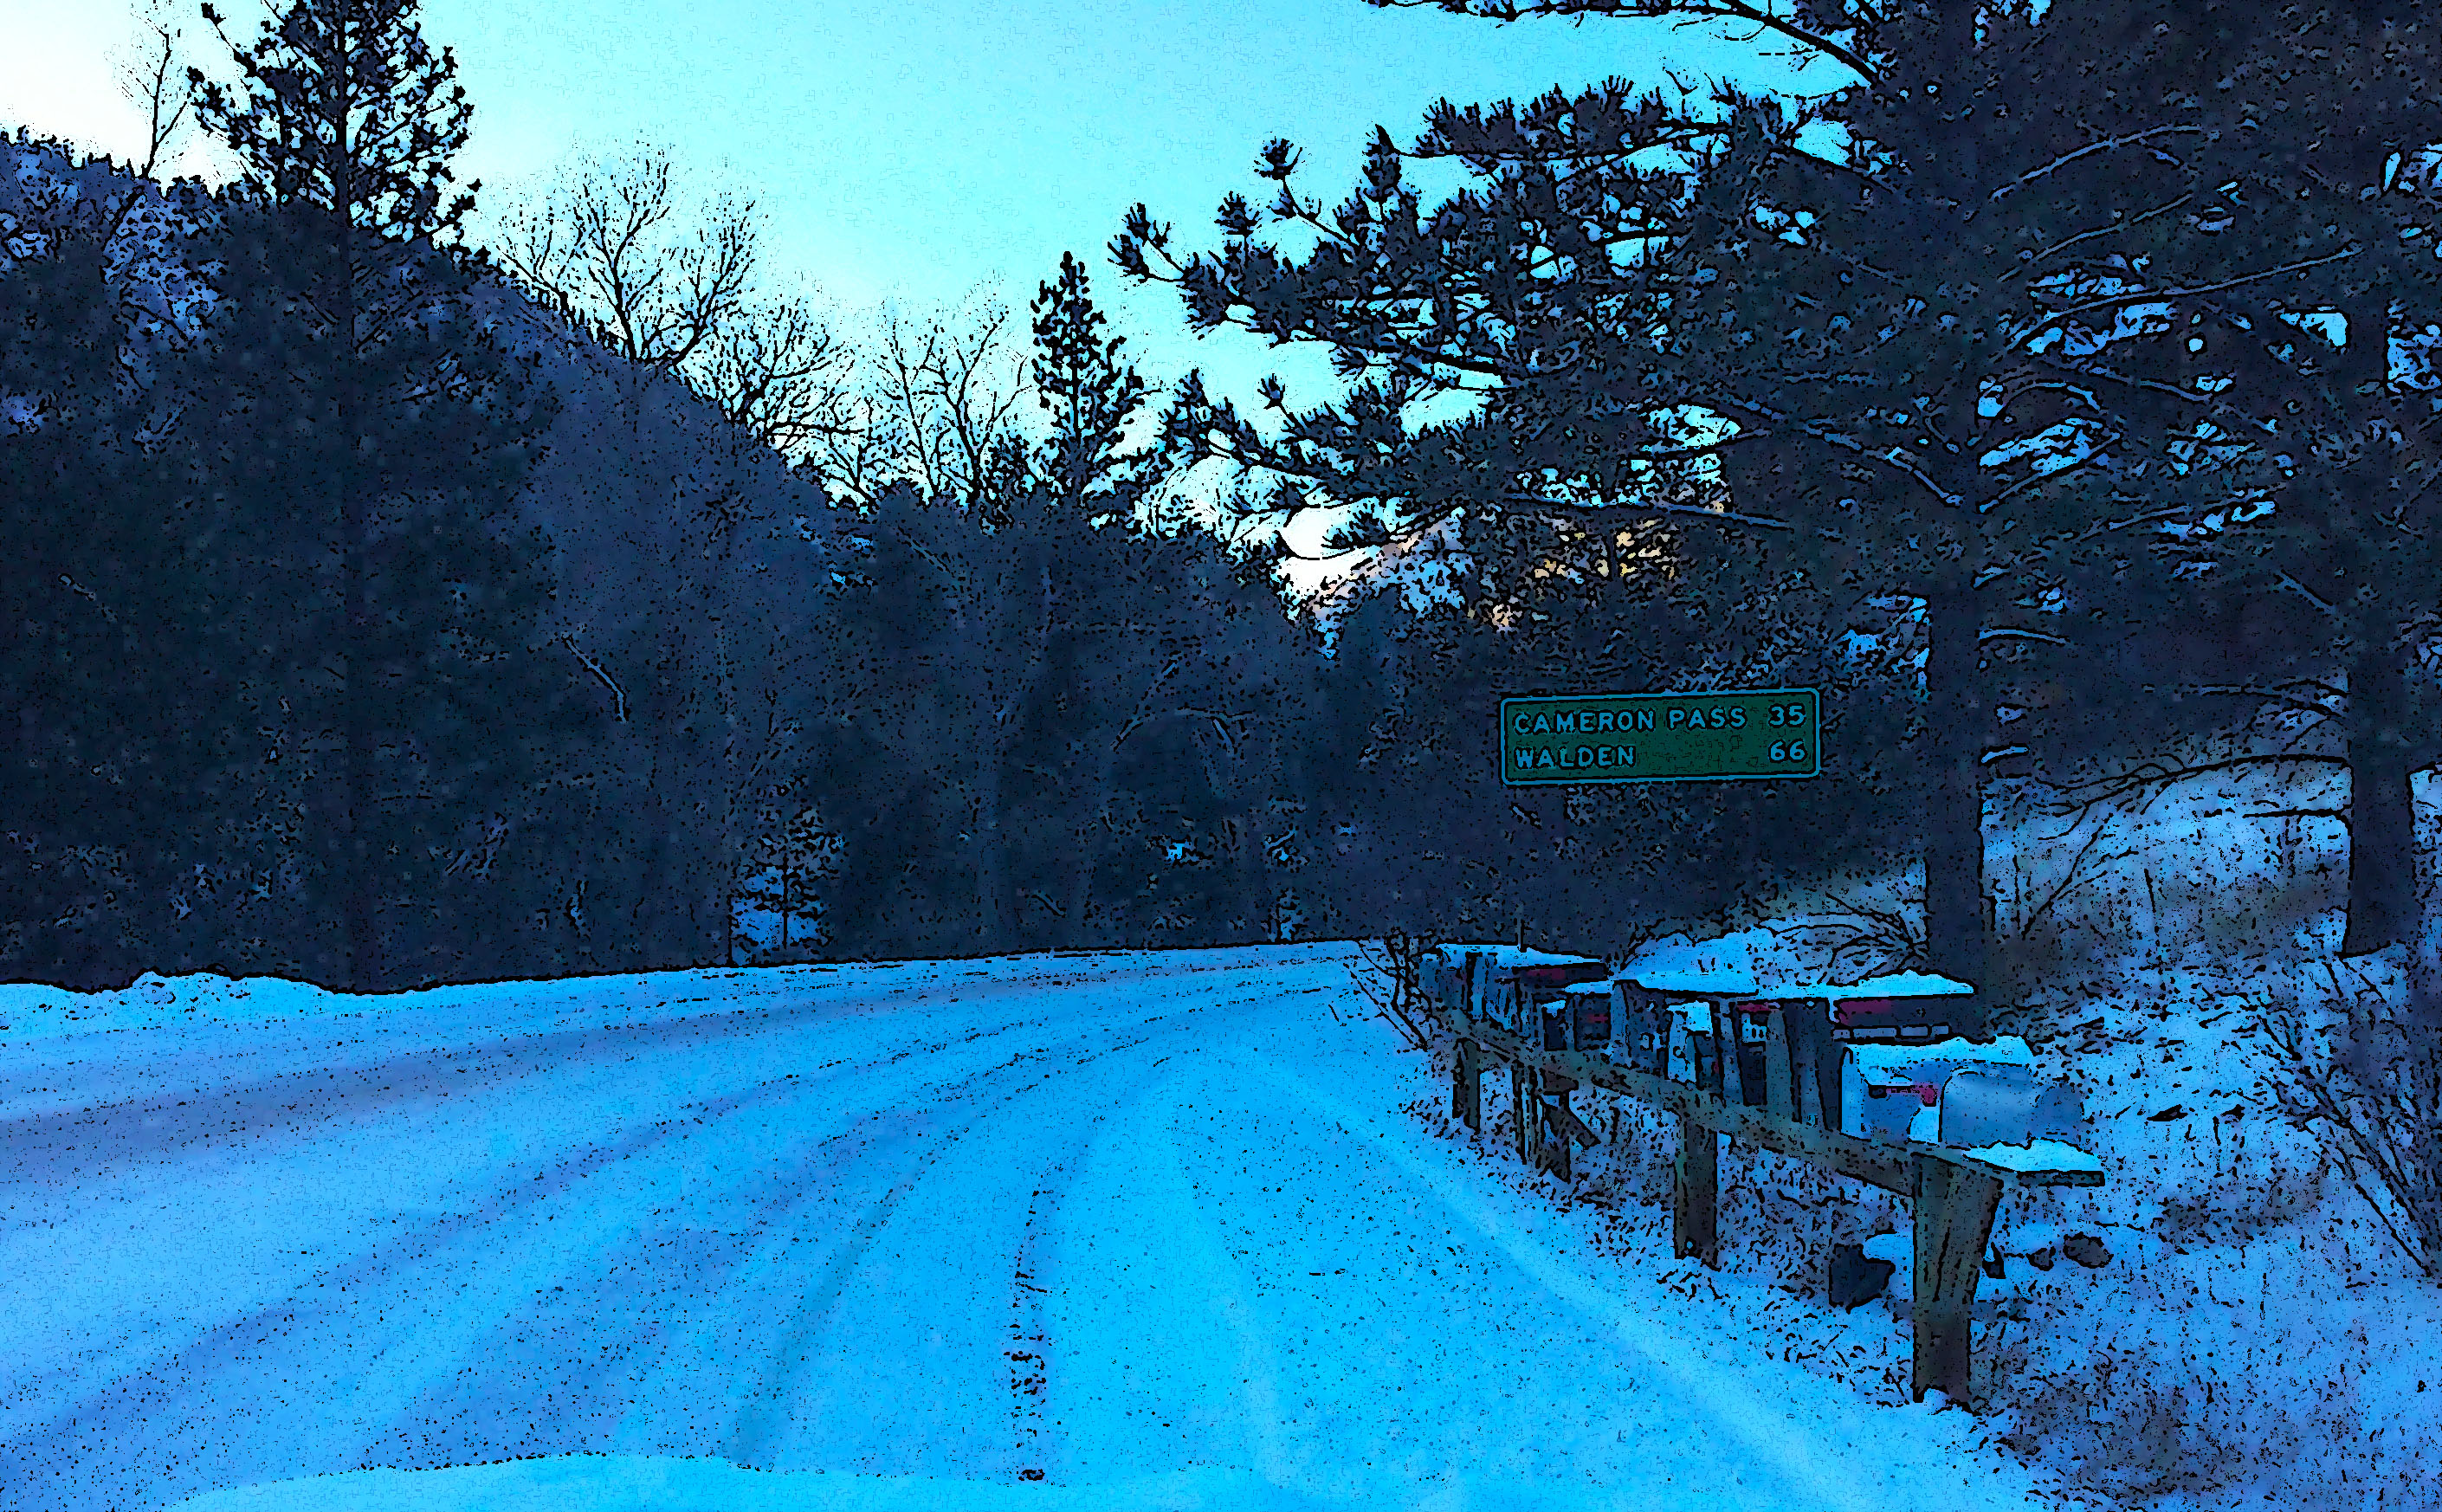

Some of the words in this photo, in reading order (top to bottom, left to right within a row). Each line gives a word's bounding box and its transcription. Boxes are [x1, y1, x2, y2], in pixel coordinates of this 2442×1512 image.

[1515, 709, 1655, 733] CAMERON
[1668, 708, 1746, 729] PASS
[1769, 704, 1806, 727] 35
[1515, 745, 1634, 768] WALDEN
[1769, 740, 1806, 762] 66
